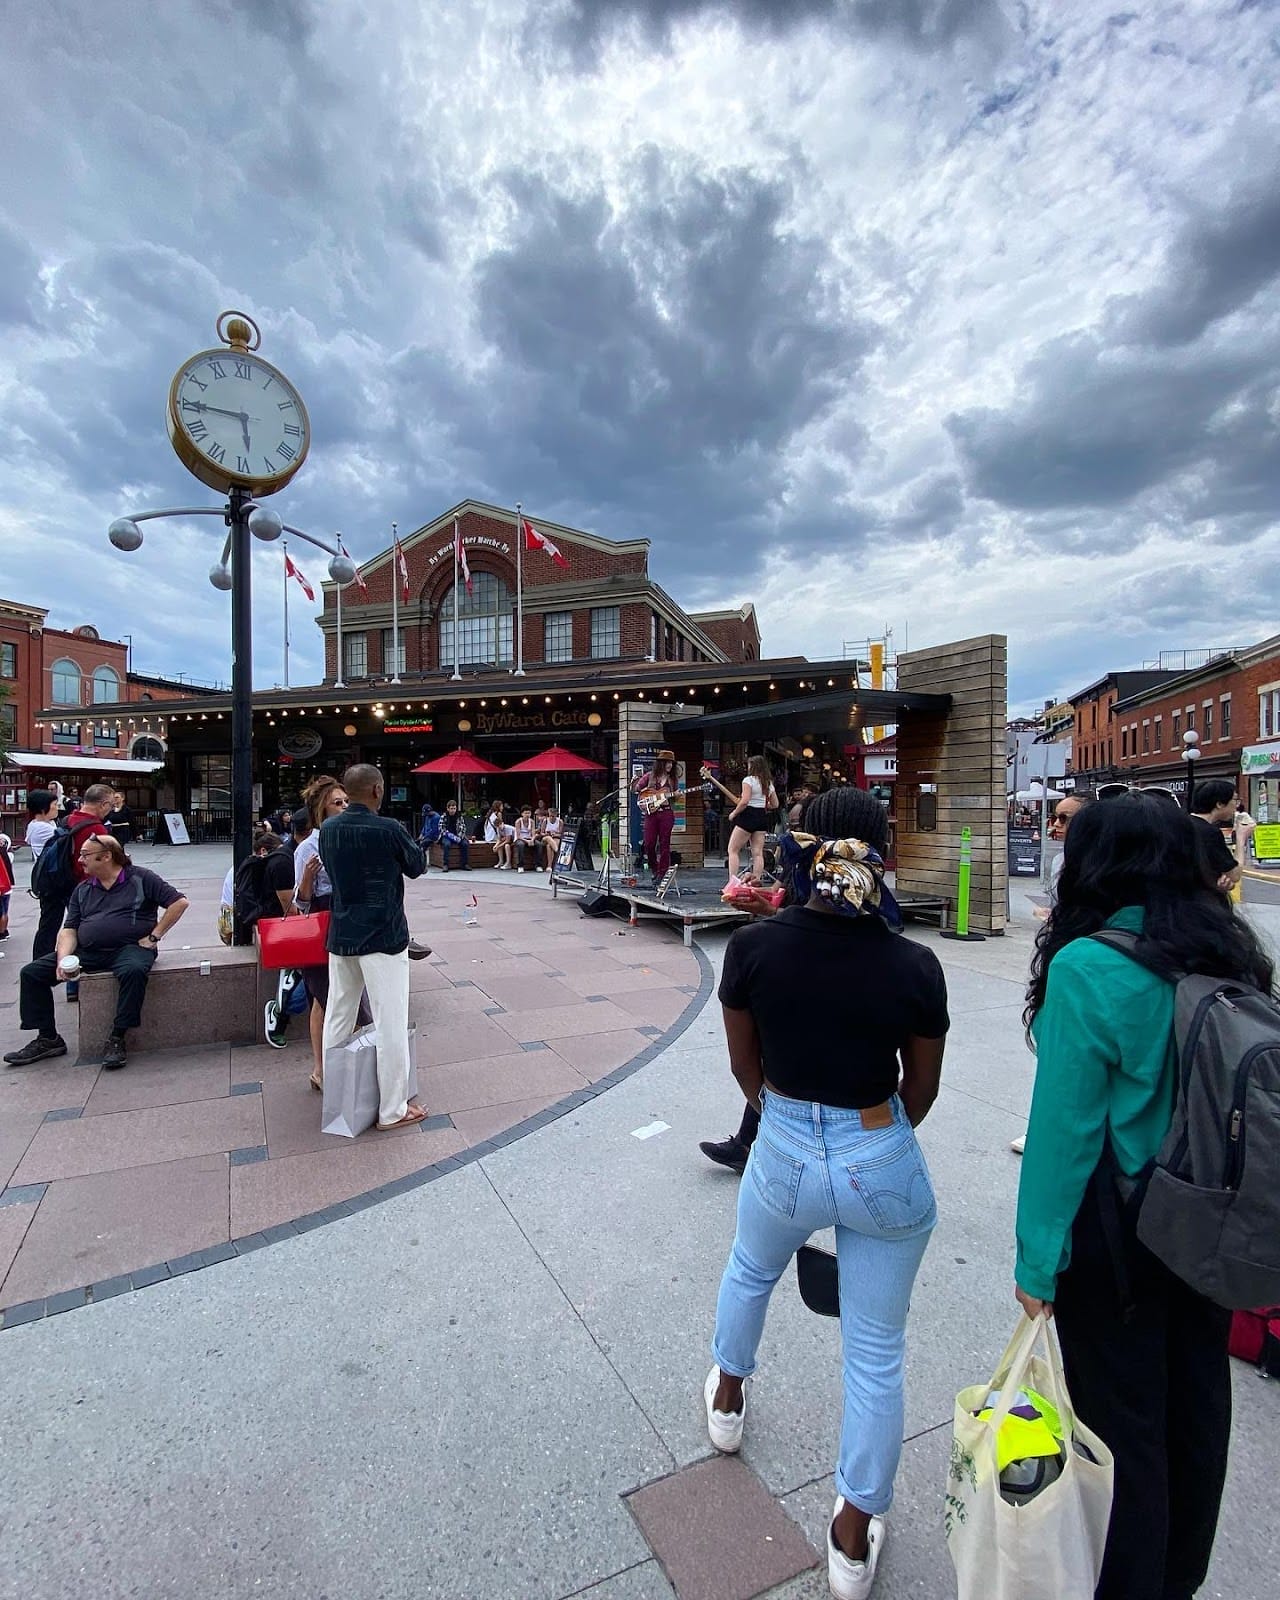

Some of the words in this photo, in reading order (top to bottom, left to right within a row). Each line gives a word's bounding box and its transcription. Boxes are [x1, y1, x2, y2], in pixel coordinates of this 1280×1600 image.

[208, 361, 227, 380] XI
[234, 361, 252, 381] XII
[189, 374, 208, 391] X
[278, 400, 293, 411] II
[186, 420, 209, 443] VIII
[284, 423, 300, 437] III
[207, 442, 227, 464] VII
[276, 441, 296, 462] IIII
[236, 456, 251, 474] VI
[264, 456, 276, 473] V
[476, 713, 546, 733] ByWard
